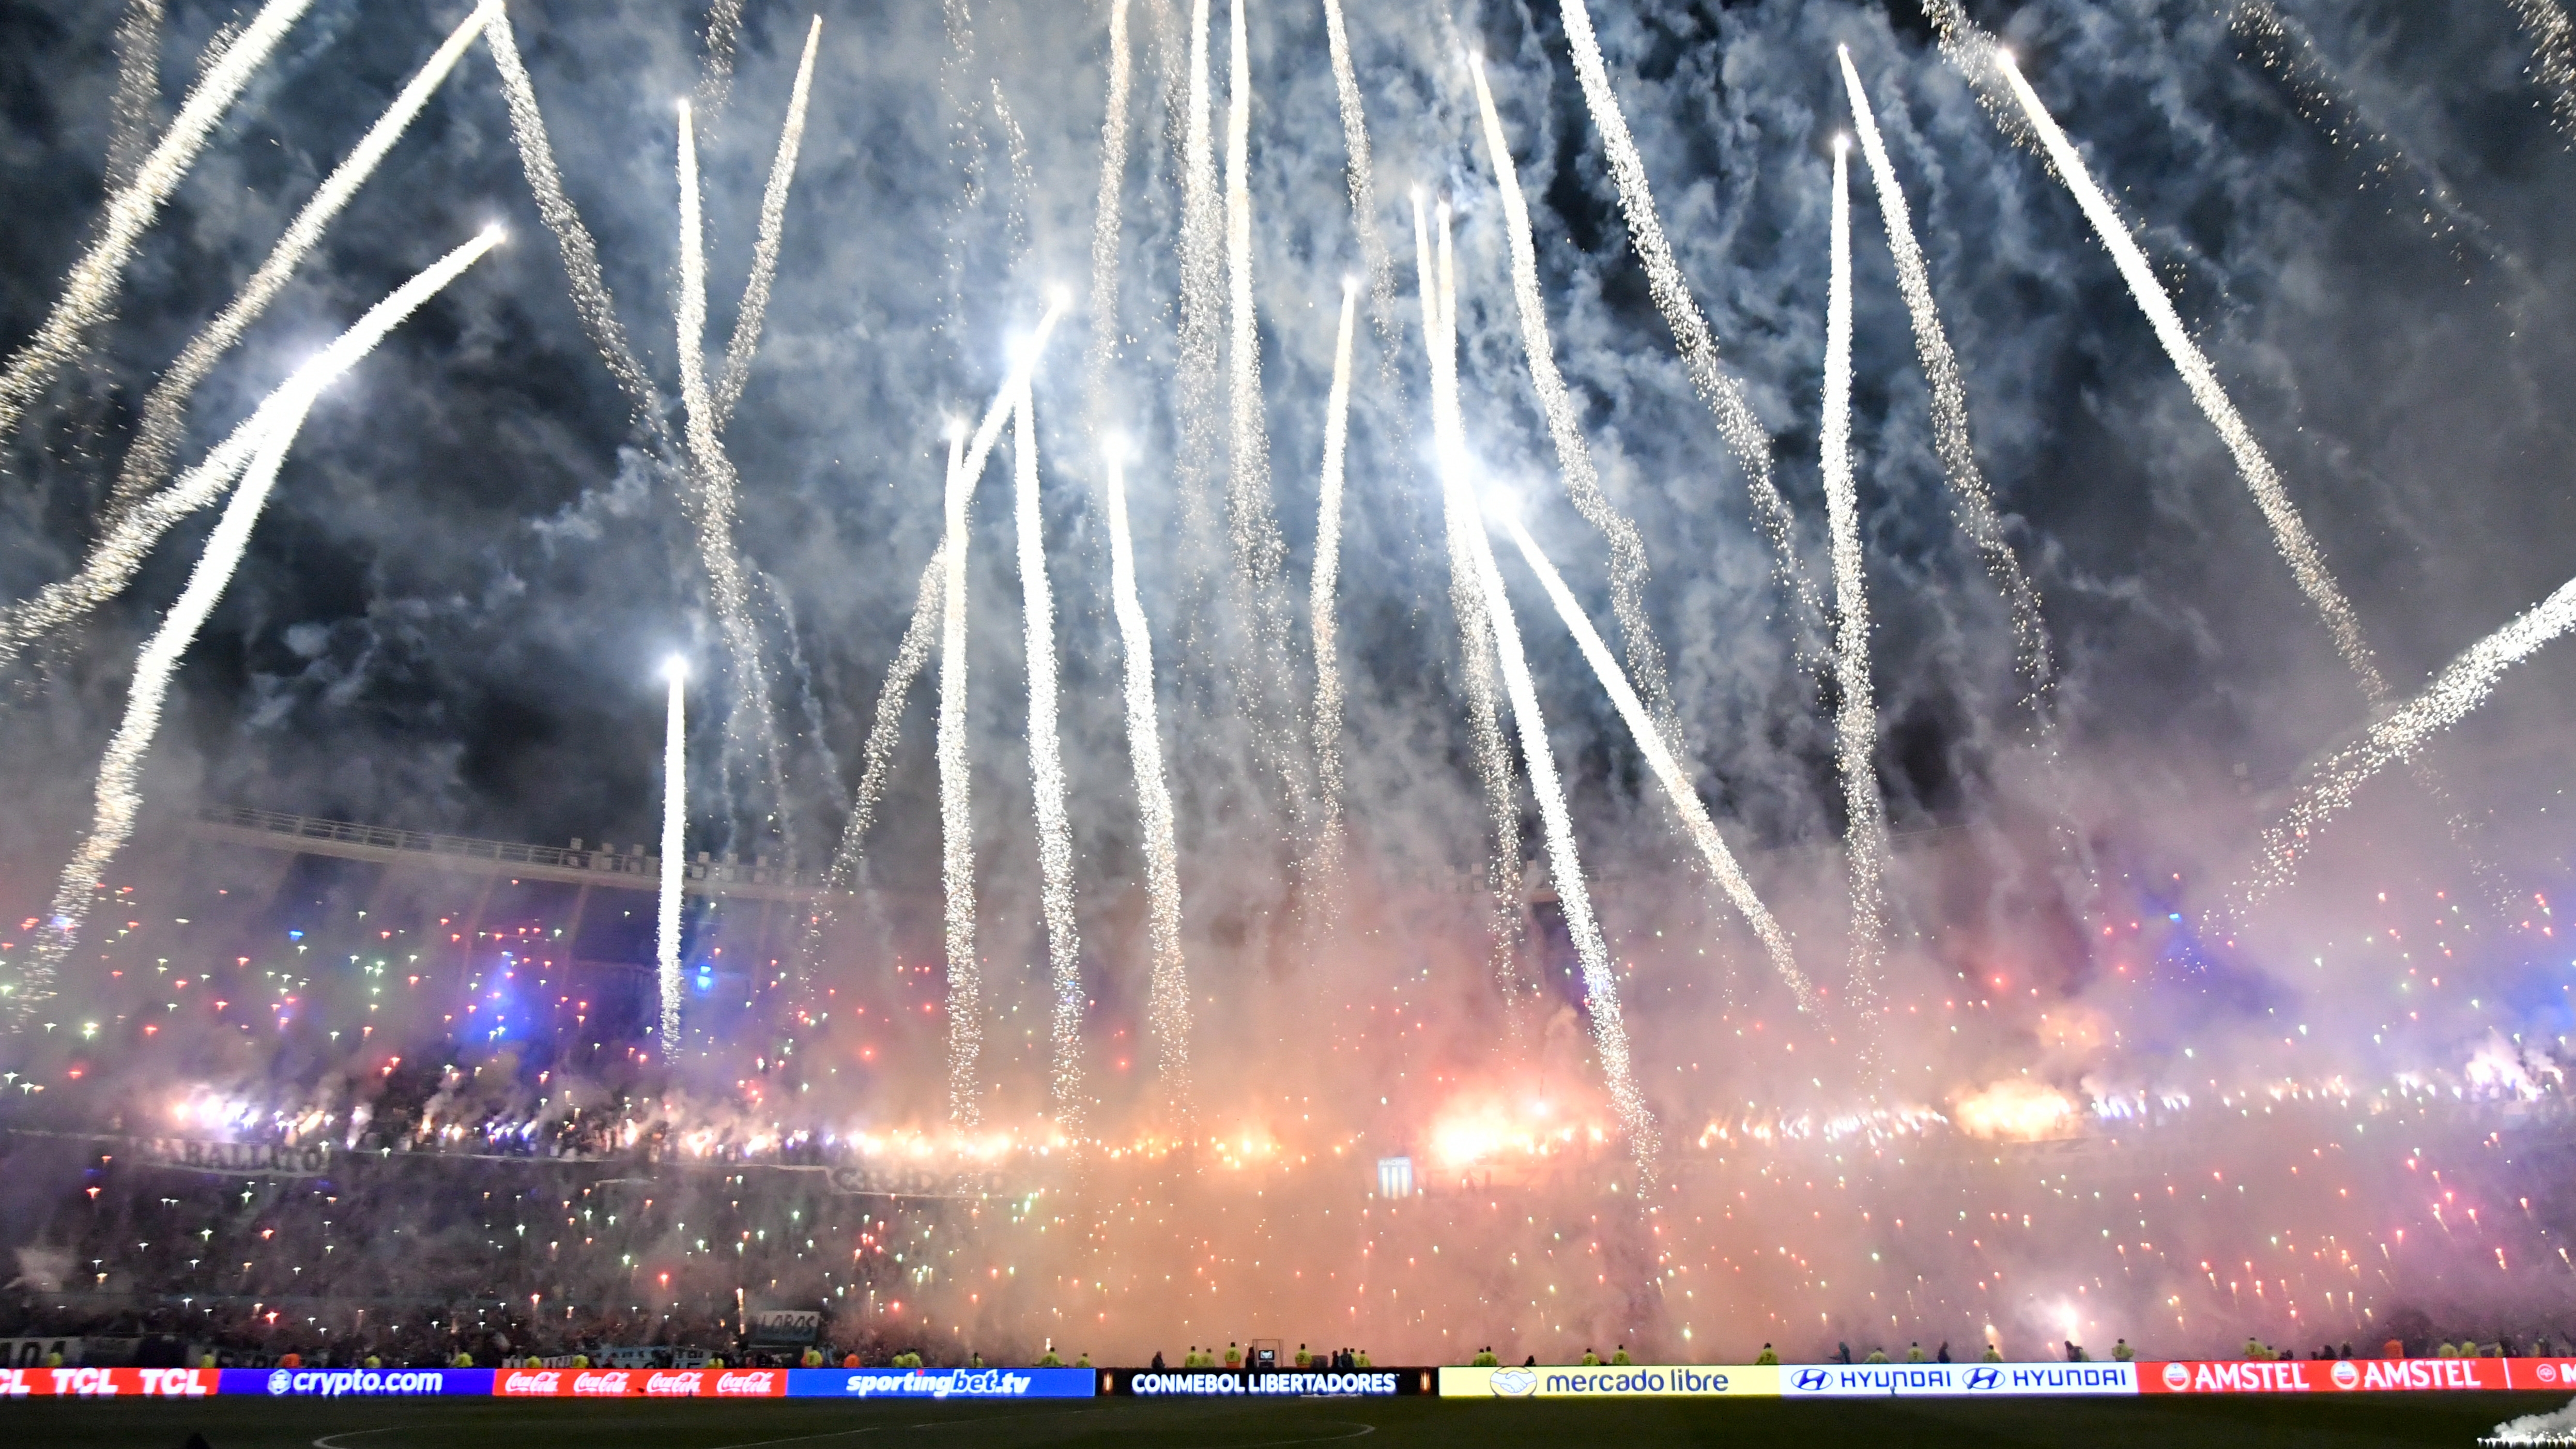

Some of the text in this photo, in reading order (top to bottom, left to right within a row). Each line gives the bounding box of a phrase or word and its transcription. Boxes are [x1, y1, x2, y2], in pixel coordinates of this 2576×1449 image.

[52, 1368, 118, 1394] TCL
[140, 1368, 206, 1394] TCL
[293, 1369, 443, 1394] crypto.com
[846, 1369, 1031, 1396] sportingbet.tv
[1132, 1374, 1396, 1393] CONMEBOL LIBERTADORES
[1547, 1369, 1728, 1392] mercado libre
[1841, 1371, 1951, 1388] HYUNDAI
[2014, 1369, 2126, 1386] HYUNDAI
[2195, 1362, 2309, 1390] AMSTEL
[2364, 1360, 2480, 1388] AMSTEL
